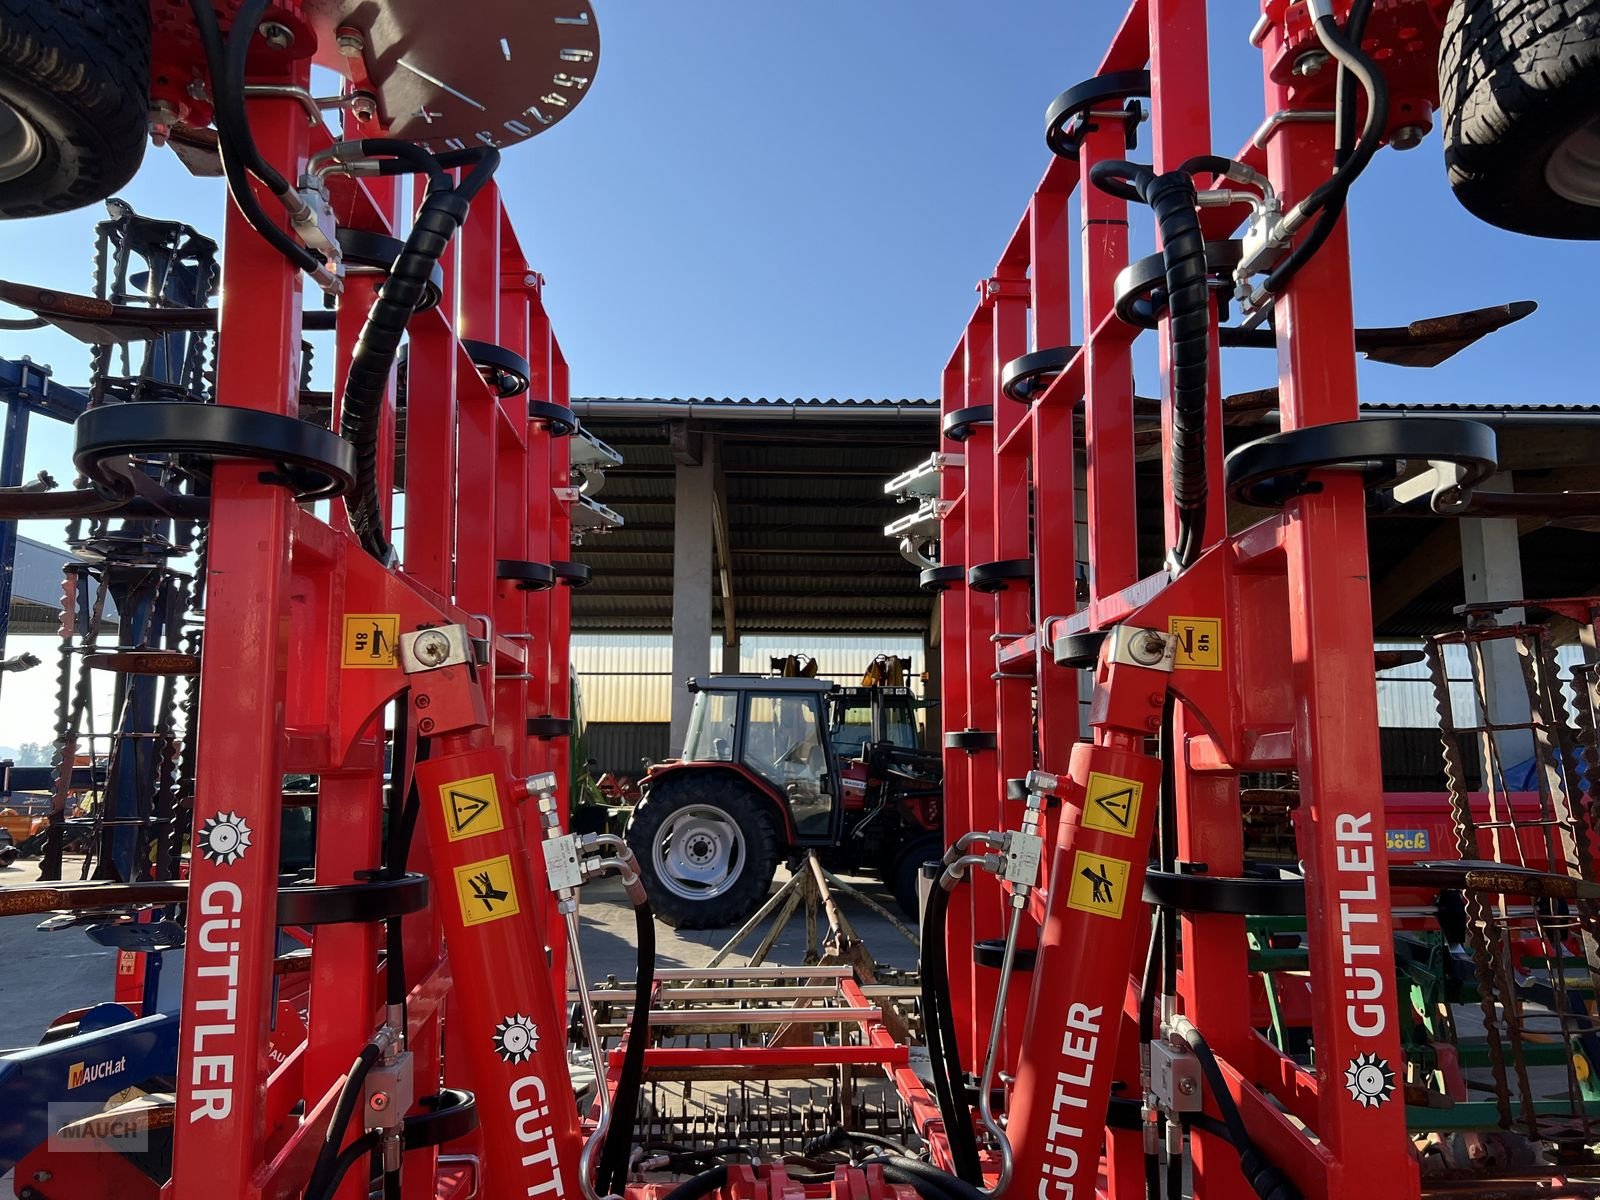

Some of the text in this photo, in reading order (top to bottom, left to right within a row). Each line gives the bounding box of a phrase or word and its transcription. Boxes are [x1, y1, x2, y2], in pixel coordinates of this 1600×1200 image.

[355, 632, 368, 651] 8h
[1198, 634, 1209, 652] 8h
[1335, 812, 1386, 1038] GÜTTLER
[190, 881, 243, 1124] GÜTTLER
[72, 1056, 126, 1088] MAUCH.at
[1038, 1002, 1104, 1200] GÜTTLER
[509, 1075, 566, 1200] GÜTT
